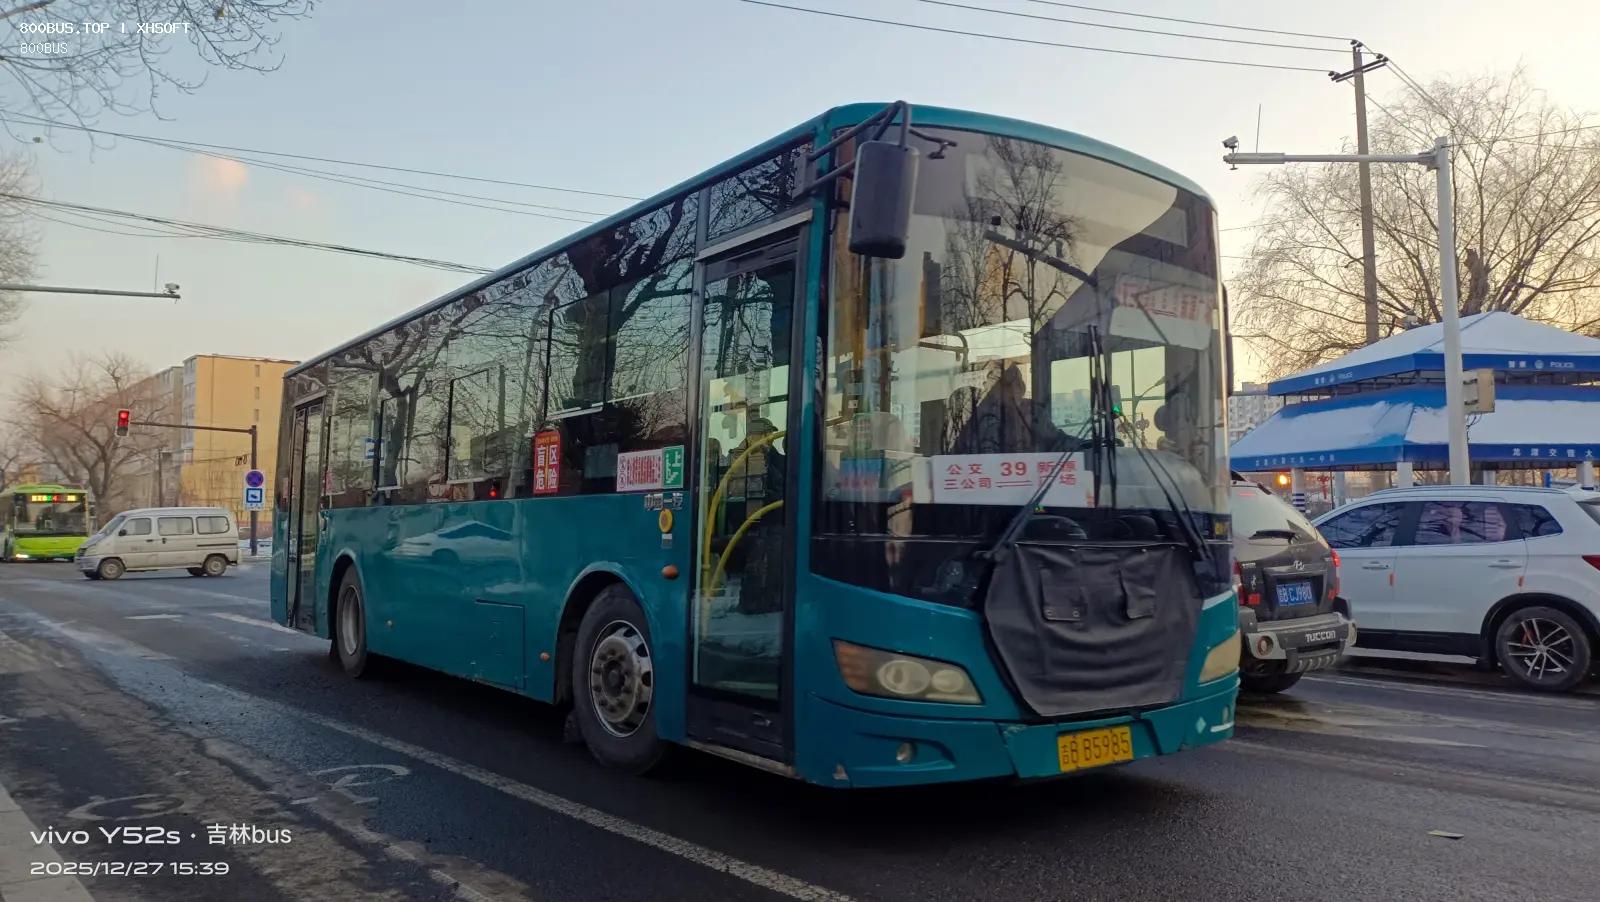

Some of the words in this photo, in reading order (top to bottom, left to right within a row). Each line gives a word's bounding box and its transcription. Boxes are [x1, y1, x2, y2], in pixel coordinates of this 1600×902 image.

[537, 444, 558, 467] 盲区
[946, 463, 982, 475] 公交
[1000, 461, 1027, 477] 39
[536, 468, 557, 490] 危险
[944, 477, 992, 490] 三公司
